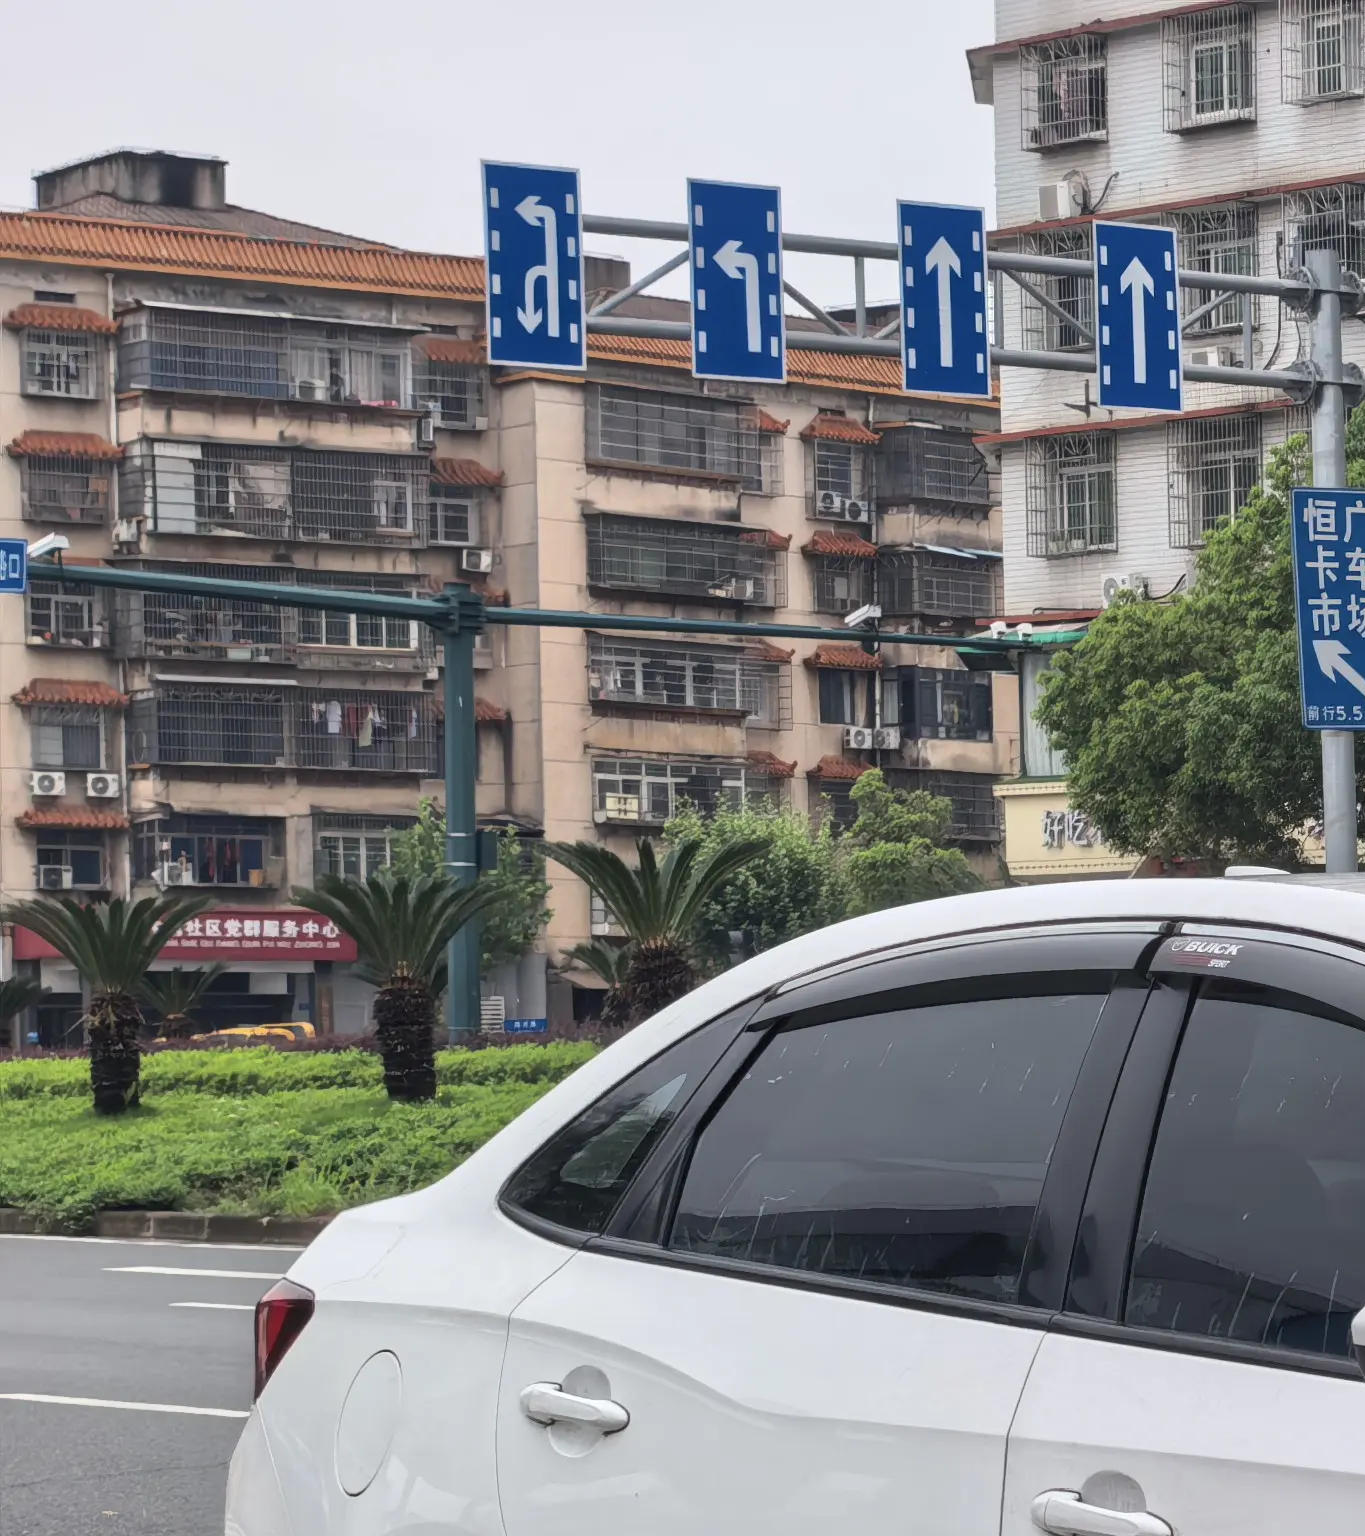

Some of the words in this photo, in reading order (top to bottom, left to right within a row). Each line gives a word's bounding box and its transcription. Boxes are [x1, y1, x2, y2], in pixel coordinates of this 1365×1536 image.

[1041, 810, 1102, 850] 好吃
[152, 918, 342, 938] 社区党群服务中心
[1184, 941, 1244, 955] BUICK
